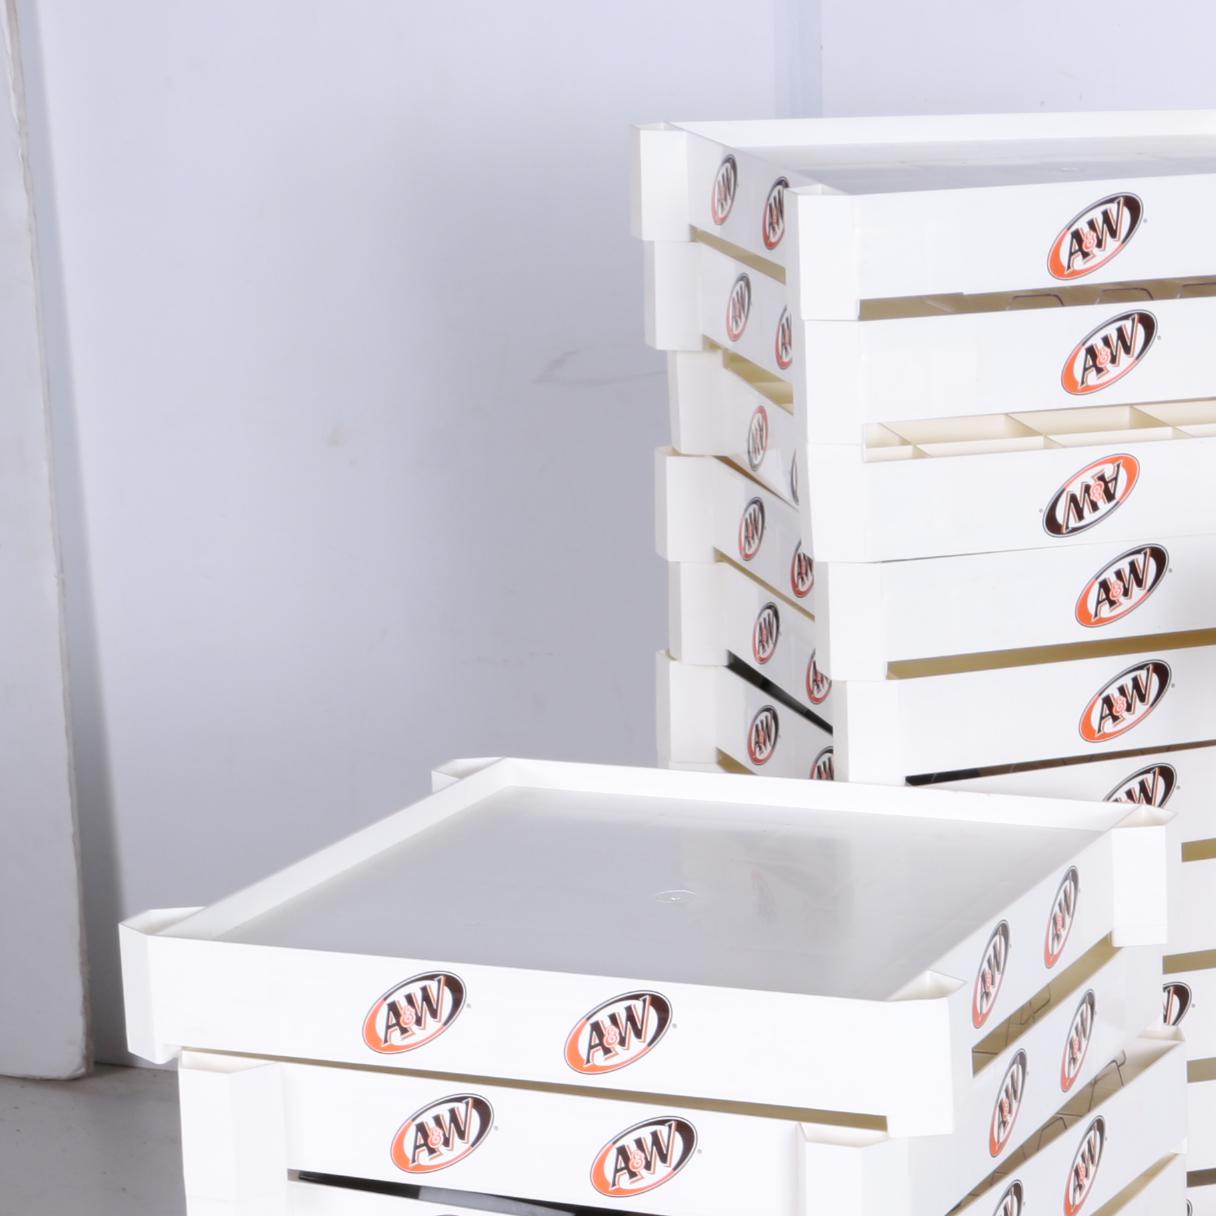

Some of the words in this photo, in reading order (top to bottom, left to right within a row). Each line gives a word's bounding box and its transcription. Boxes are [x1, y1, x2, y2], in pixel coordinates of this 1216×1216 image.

[1065, 196, 1125, 274] A&W
[1079, 313, 1139, 389] A&W
[1061, 459, 1122, 534] A&W
[1092, 547, 1151, 621] A&W
[1096, 663, 1154, 737] A&W
[382, 975, 445, 1047] A&W
[584, 994, 651, 1068] A&W
[410, 1097, 473, 1167] A&W
[610, 1120, 676, 1191] A&W
